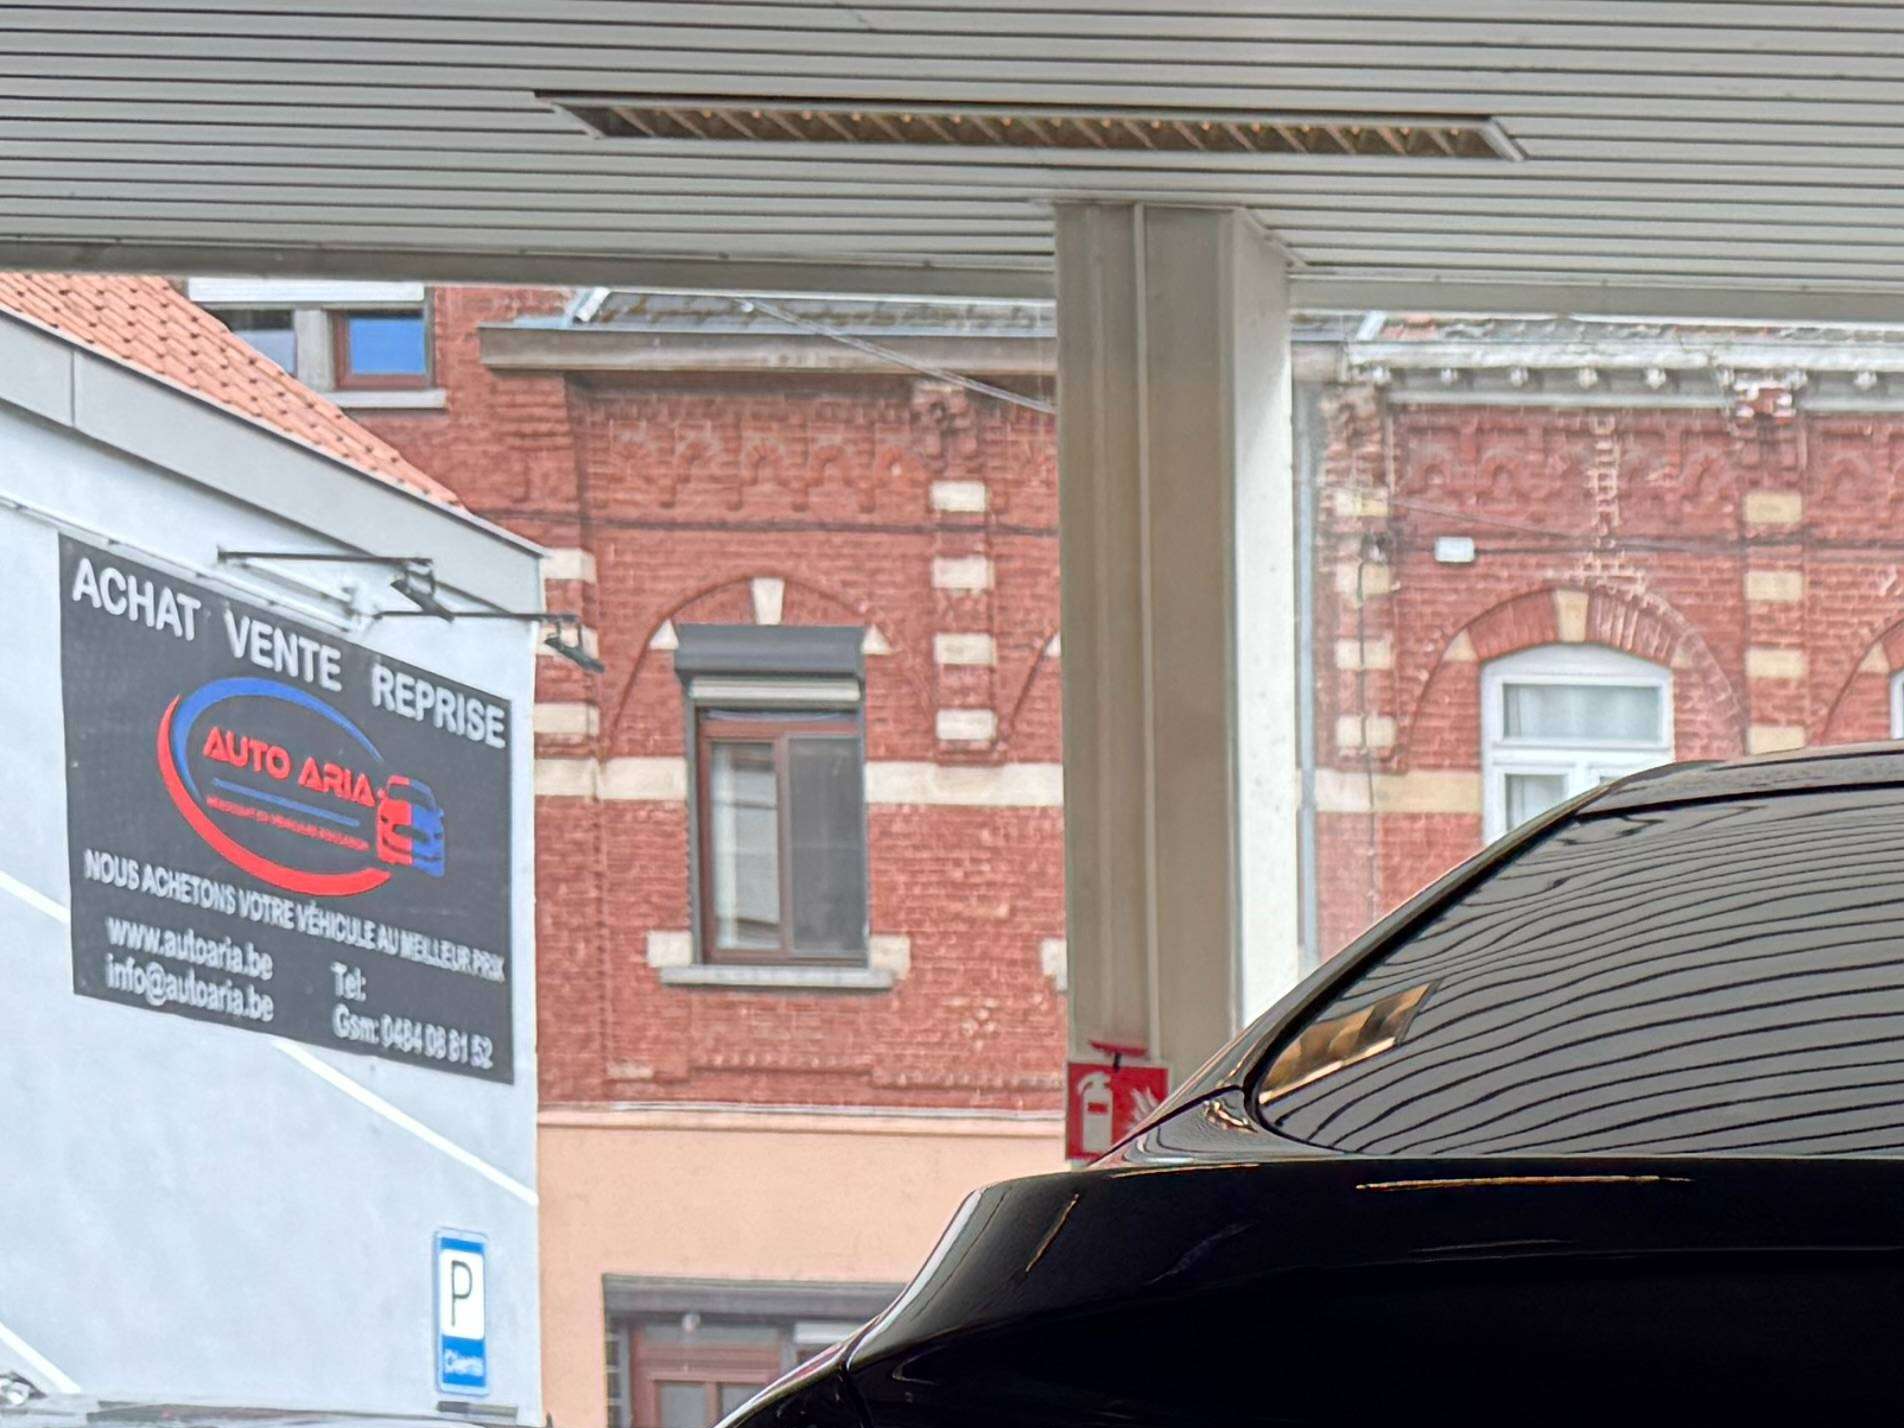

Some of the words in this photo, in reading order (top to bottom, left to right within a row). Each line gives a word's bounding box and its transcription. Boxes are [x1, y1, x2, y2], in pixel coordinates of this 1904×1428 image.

[72, 558, 202, 641] ACHAT
[223, 609, 343, 692] VENTE
[371, 662, 506, 749] REPRISE
[203, 726, 291, 780] AUTO
[297, 757, 375, 807] ARIA
[84, 848, 140, 890] NOUS
[141, 864, 236, 914] ACHETONS
[239, 887, 295, 929] VOTRE
[377, 923, 400, 955] AU
[106, 916, 273, 980] www.autoaria.be
[331, 961, 367, 1002] Tel:
[105, 952, 274, 1022] info@autoaria.be
[332, 1003, 380, 1044] Gsm:
[470, 1034, 494, 1069] 52
[451, 1260, 473, 1327] P
